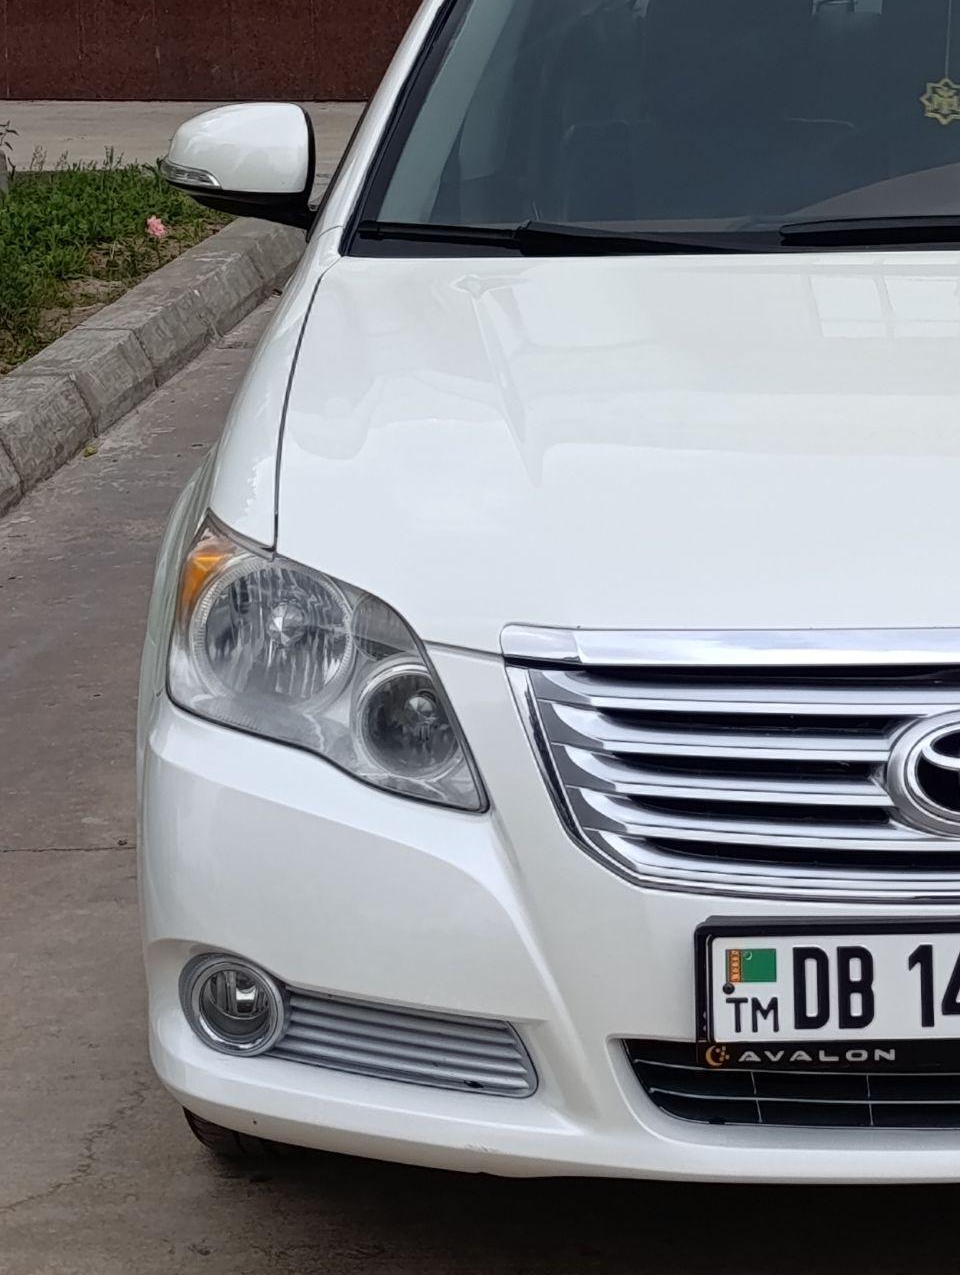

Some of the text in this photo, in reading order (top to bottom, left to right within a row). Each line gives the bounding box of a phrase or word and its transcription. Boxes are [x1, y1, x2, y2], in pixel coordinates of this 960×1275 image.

[793, 946, 875, 1029] DB
[726, 997, 779, 1033] TM
[738, 1048, 896, 1063] AVALON
